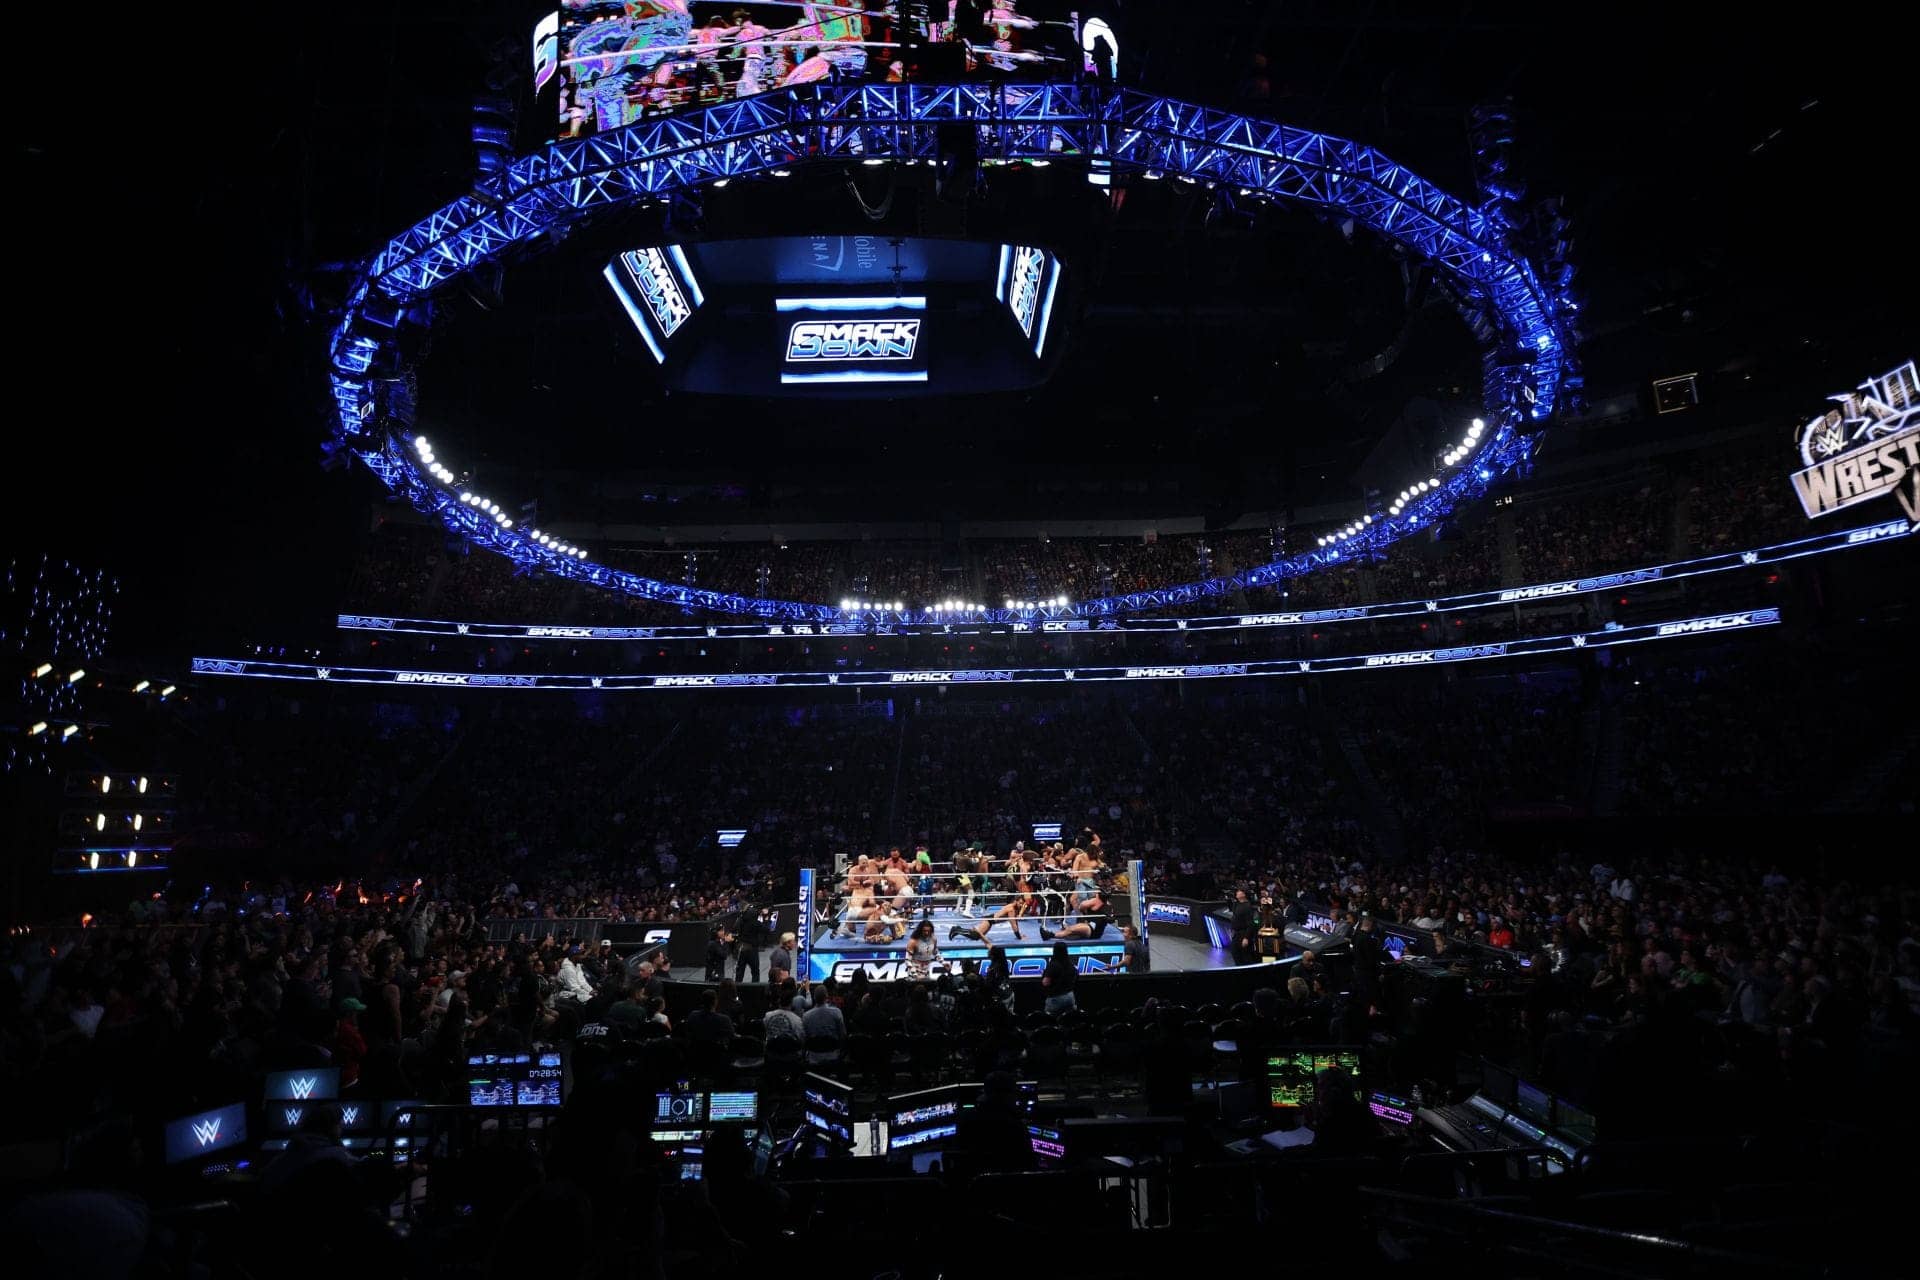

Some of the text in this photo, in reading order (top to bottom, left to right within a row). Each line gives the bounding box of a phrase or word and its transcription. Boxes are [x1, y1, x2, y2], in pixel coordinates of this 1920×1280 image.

[855, 236, 876, 269] obile
[792, 323, 917, 345] SMACK
[790, 336, 912, 358] DOWN
